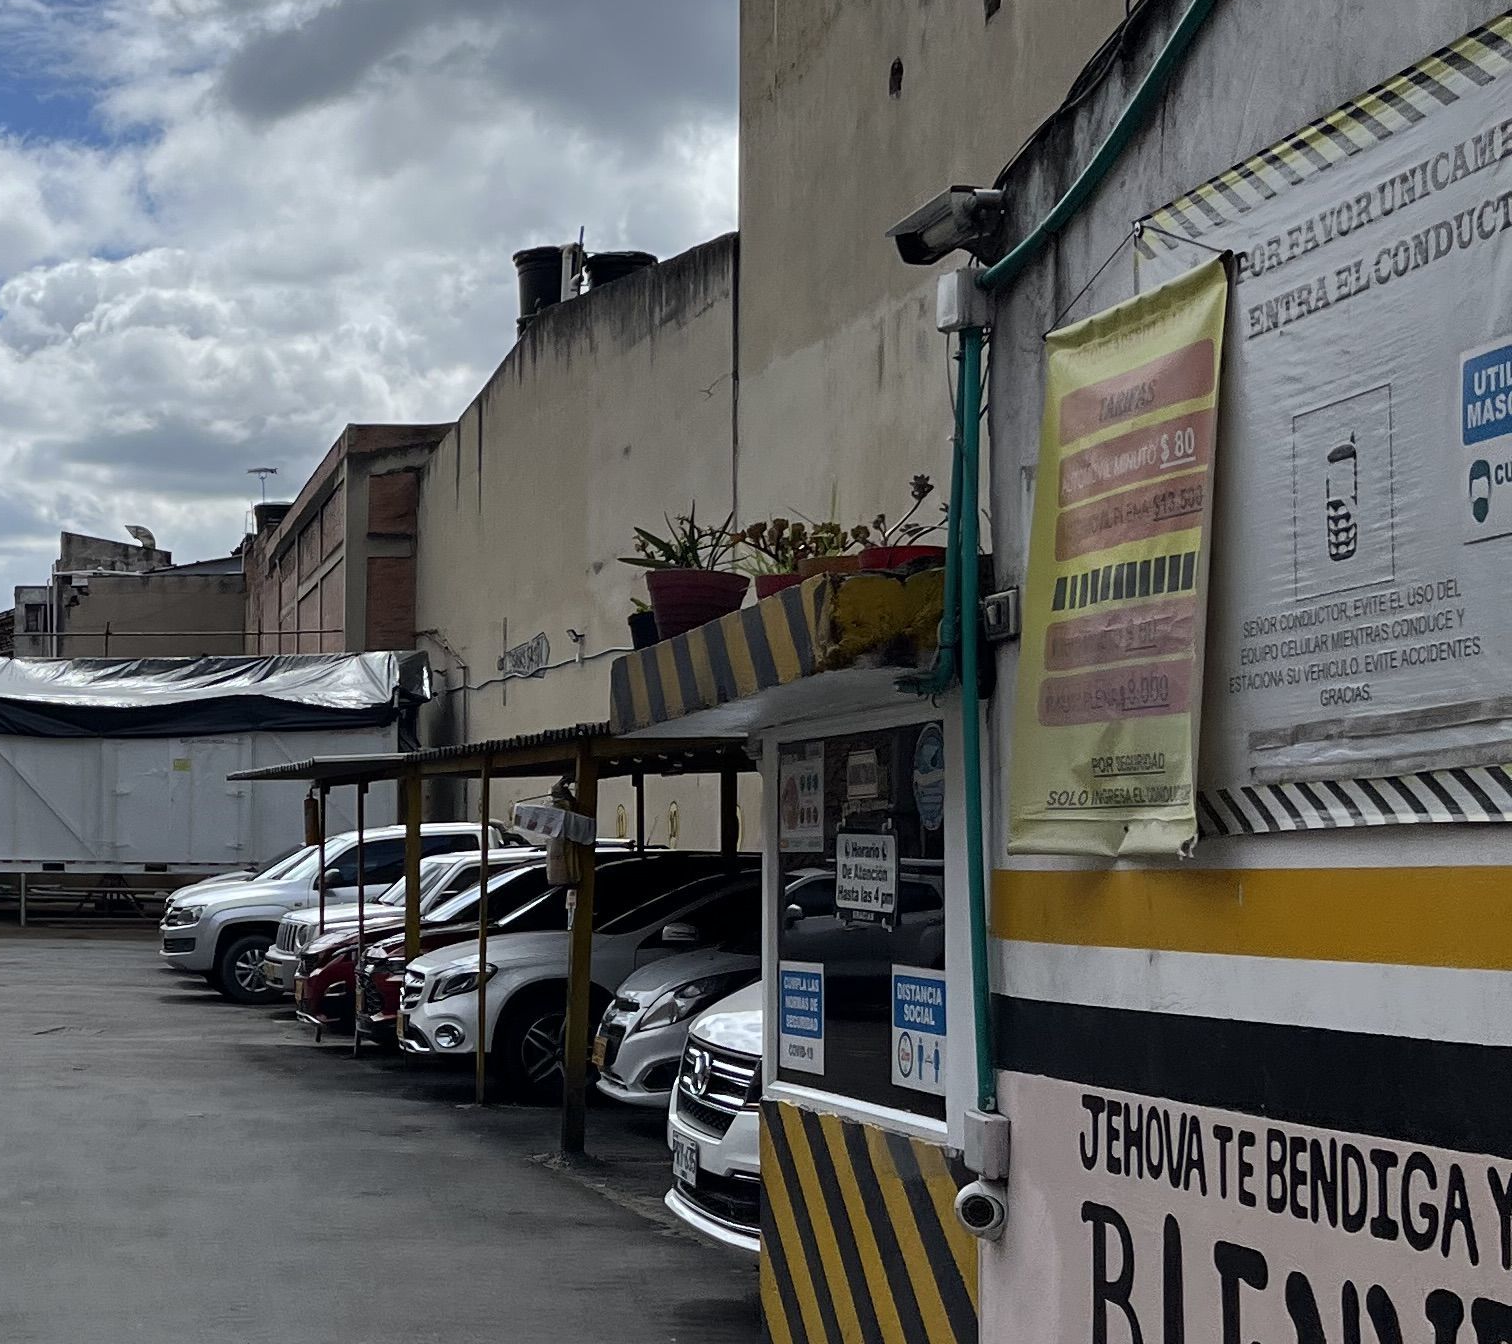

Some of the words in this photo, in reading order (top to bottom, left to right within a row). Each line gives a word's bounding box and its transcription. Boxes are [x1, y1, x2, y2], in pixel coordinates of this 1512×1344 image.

[1236, 235, 1282, 285] POR
[1286, 191, 1375, 262] FAVOR
[1248, 275, 1332, 339] ENTRA
[1333, 259, 1372, 304] EL
[1159, 432, 1170, 463] $
[1174, 426, 1196, 455] 80
[1243, 614, 1278, 640] SEÑOR
[1353, 593, 1387, 618] EVITE
[1389, 591, 1405, 610] EL
[1407, 582, 1435, 606] USO
[1437, 577, 1463, 599] DEL
[1240, 642, 1279, 666] EQUIPO
[1280, 633, 1330, 659] CELULAR
[1330, 622, 1389, 650] MIENTRAS
[1391, 609, 1454, 639] CONDUCE
[1454, 607, 1466, 628] Y
[1229, 669, 1285, 694] ESTACIONA
[1286, 666, 1302, 686] SU
[1365, 649, 1399, 674] EVITE
[1046, 789, 1088, 808] SOLO
[1090, 787, 1131, 806] INGRESA
[851, 841, 881, 858] Horario
[841, 862, 853, 880] De
[838, 884, 860, 903] Hasta
[860, 885, 873, 904] las
[896, 982, 943, 1007] DISTANCIA
[903, 1003, 936, 1026] SOCIAL
[1080, 1094, 1208, 1197] JEHOVA
[1213, 1123, 1257, 1208] TE
[1266, 1127, 1480, 1266] BENDIGA
